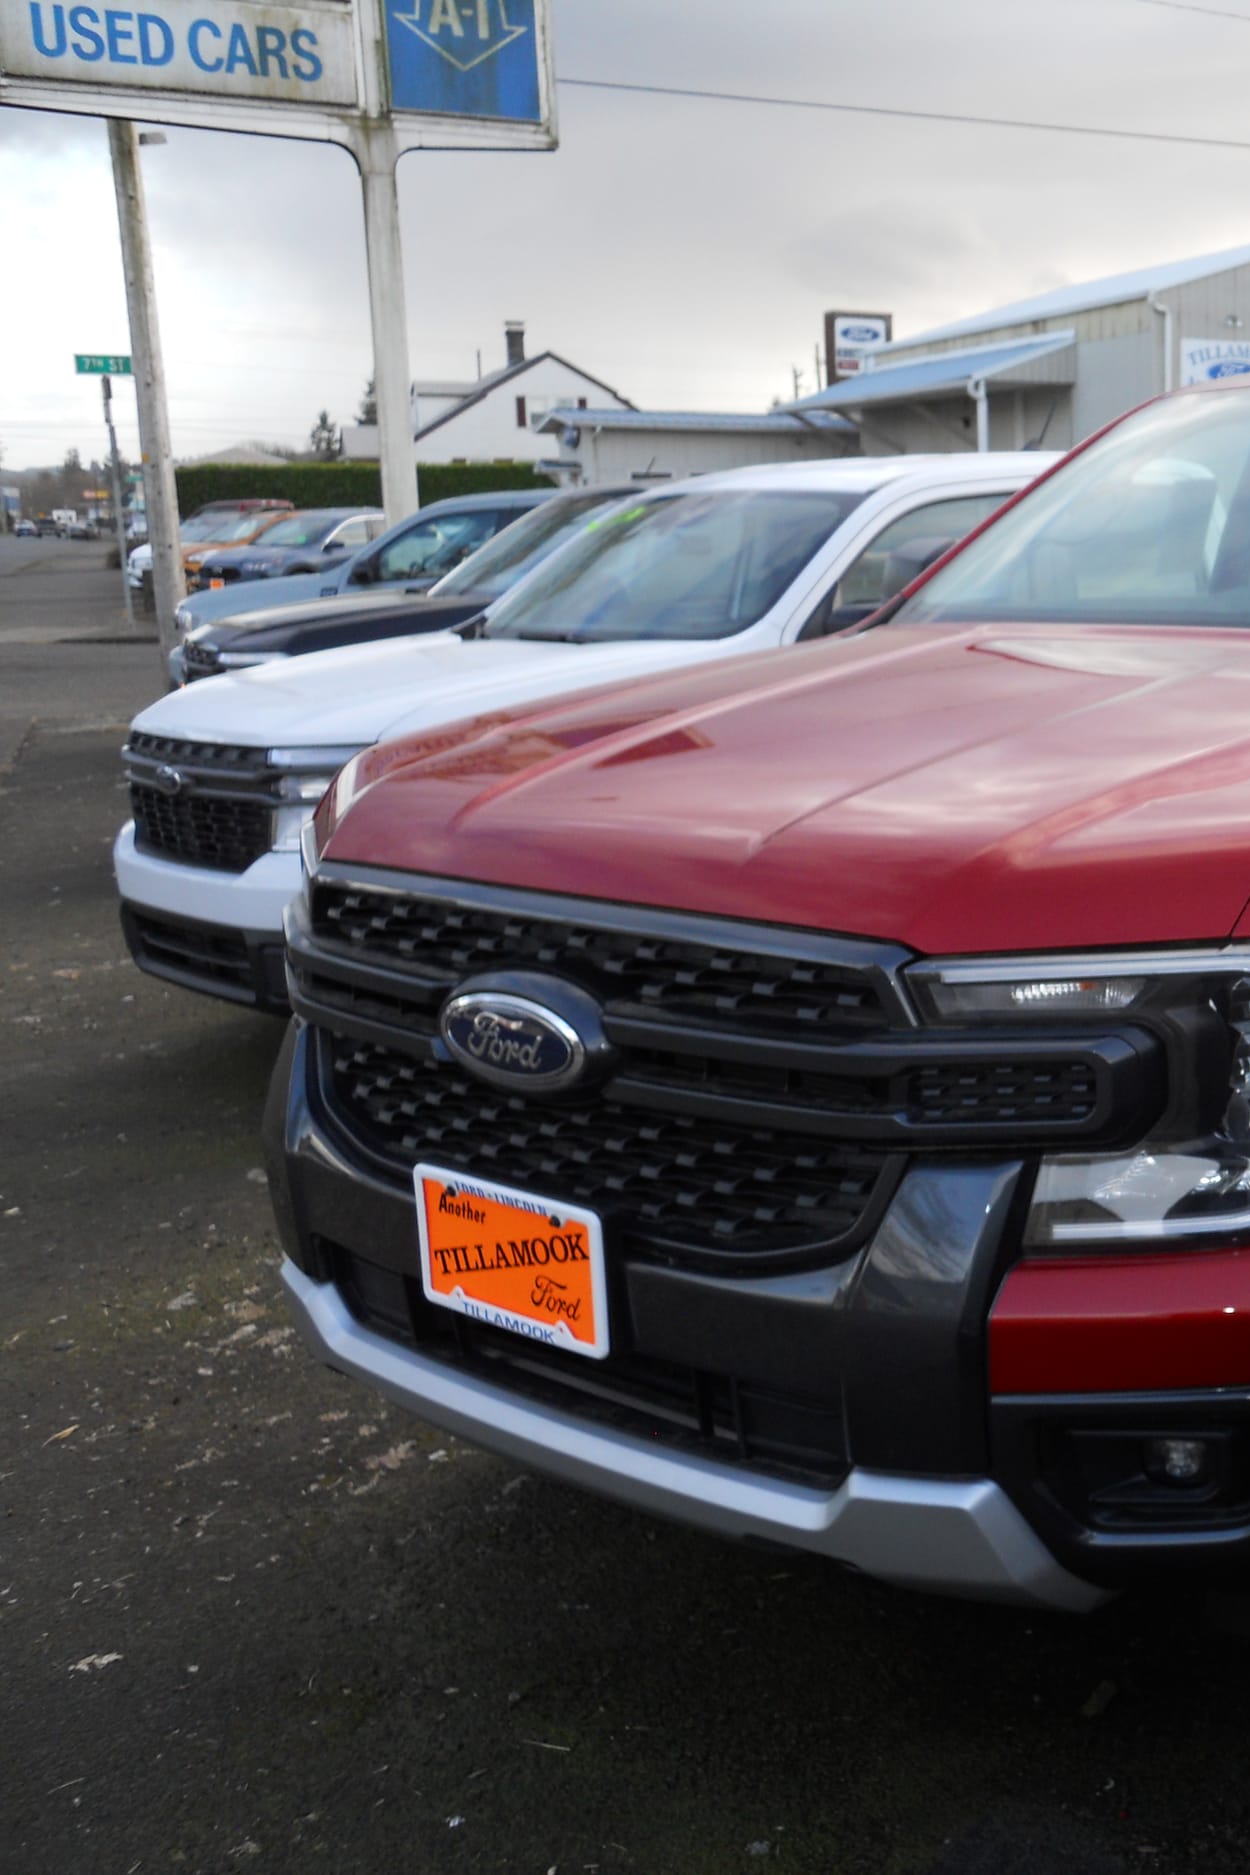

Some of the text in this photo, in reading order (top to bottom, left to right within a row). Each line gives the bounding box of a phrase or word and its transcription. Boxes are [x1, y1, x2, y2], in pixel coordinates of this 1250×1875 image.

[29, 2, 323, 82] USED CARS
[467, 1011, 542, 1069] Ford
[439, 1195, 486, 1225] Another
[434, 1233, 590, 1275] TILLAMOOK
[531, 1274, 581, 1321] Ford
[462, 1301, 555, 1343] TILLAMOOK
